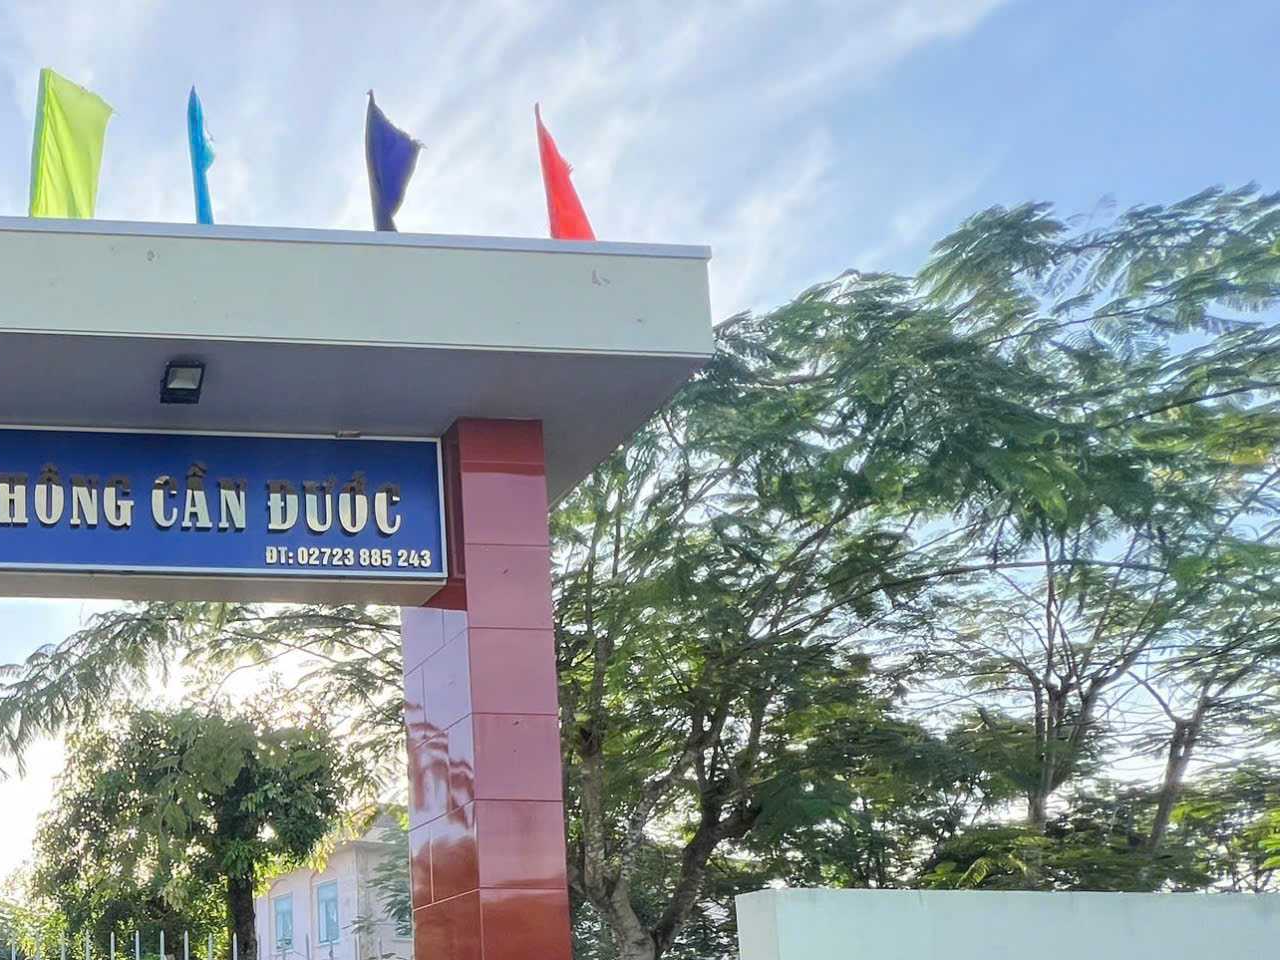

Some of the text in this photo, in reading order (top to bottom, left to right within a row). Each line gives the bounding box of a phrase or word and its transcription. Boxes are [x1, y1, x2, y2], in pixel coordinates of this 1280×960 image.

[151, 461, 248, 530] CẦN
[265, 471, 402, 536] ĐƯỚC
[297, 546, 355, 566] 02723
[359, 548, 393, 567] 885
[397, 549, 432, 568] 243
